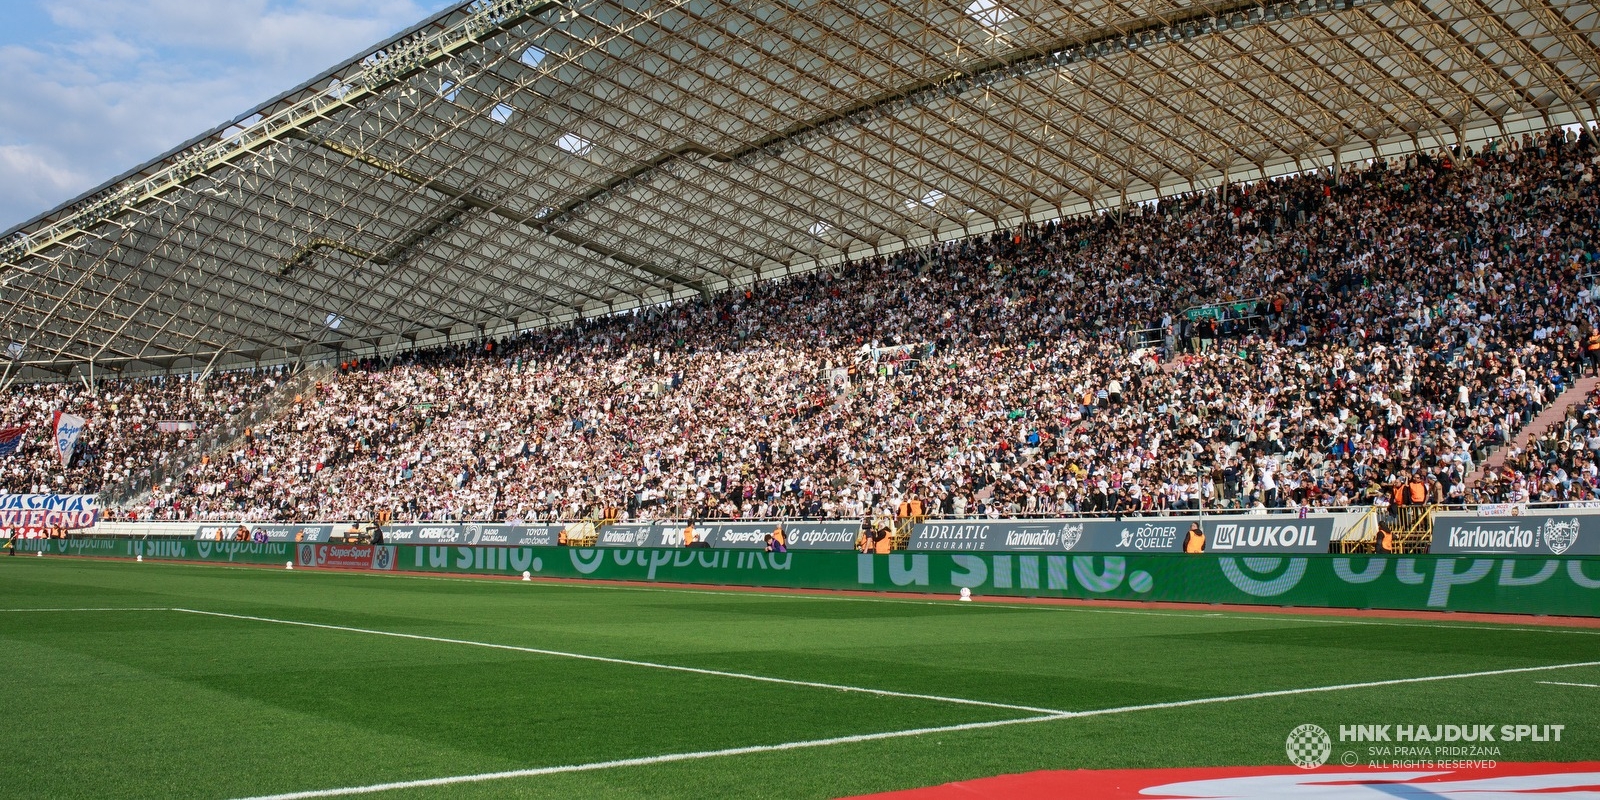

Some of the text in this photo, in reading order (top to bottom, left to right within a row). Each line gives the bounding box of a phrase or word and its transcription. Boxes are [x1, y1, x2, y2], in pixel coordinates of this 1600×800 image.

[419, 528, 455, 539] ORBICO
[526, 528, 549, 536] TOYOTA
[801, 528, 854, 545] otpbanka
[919, 525, 990, 539] ADRIATIC
[1005, 529, 1056, 546] Karlovačko
[1236, 525, 1317, 547] LUKOIL
[1449, 526, 1533, 548] Karlovačko
[917, 541, 986, 550] OSIGURANJE
[1134, 537, 1174, 550] QUELLE
[330, 545, 372, 559] SuperSport
